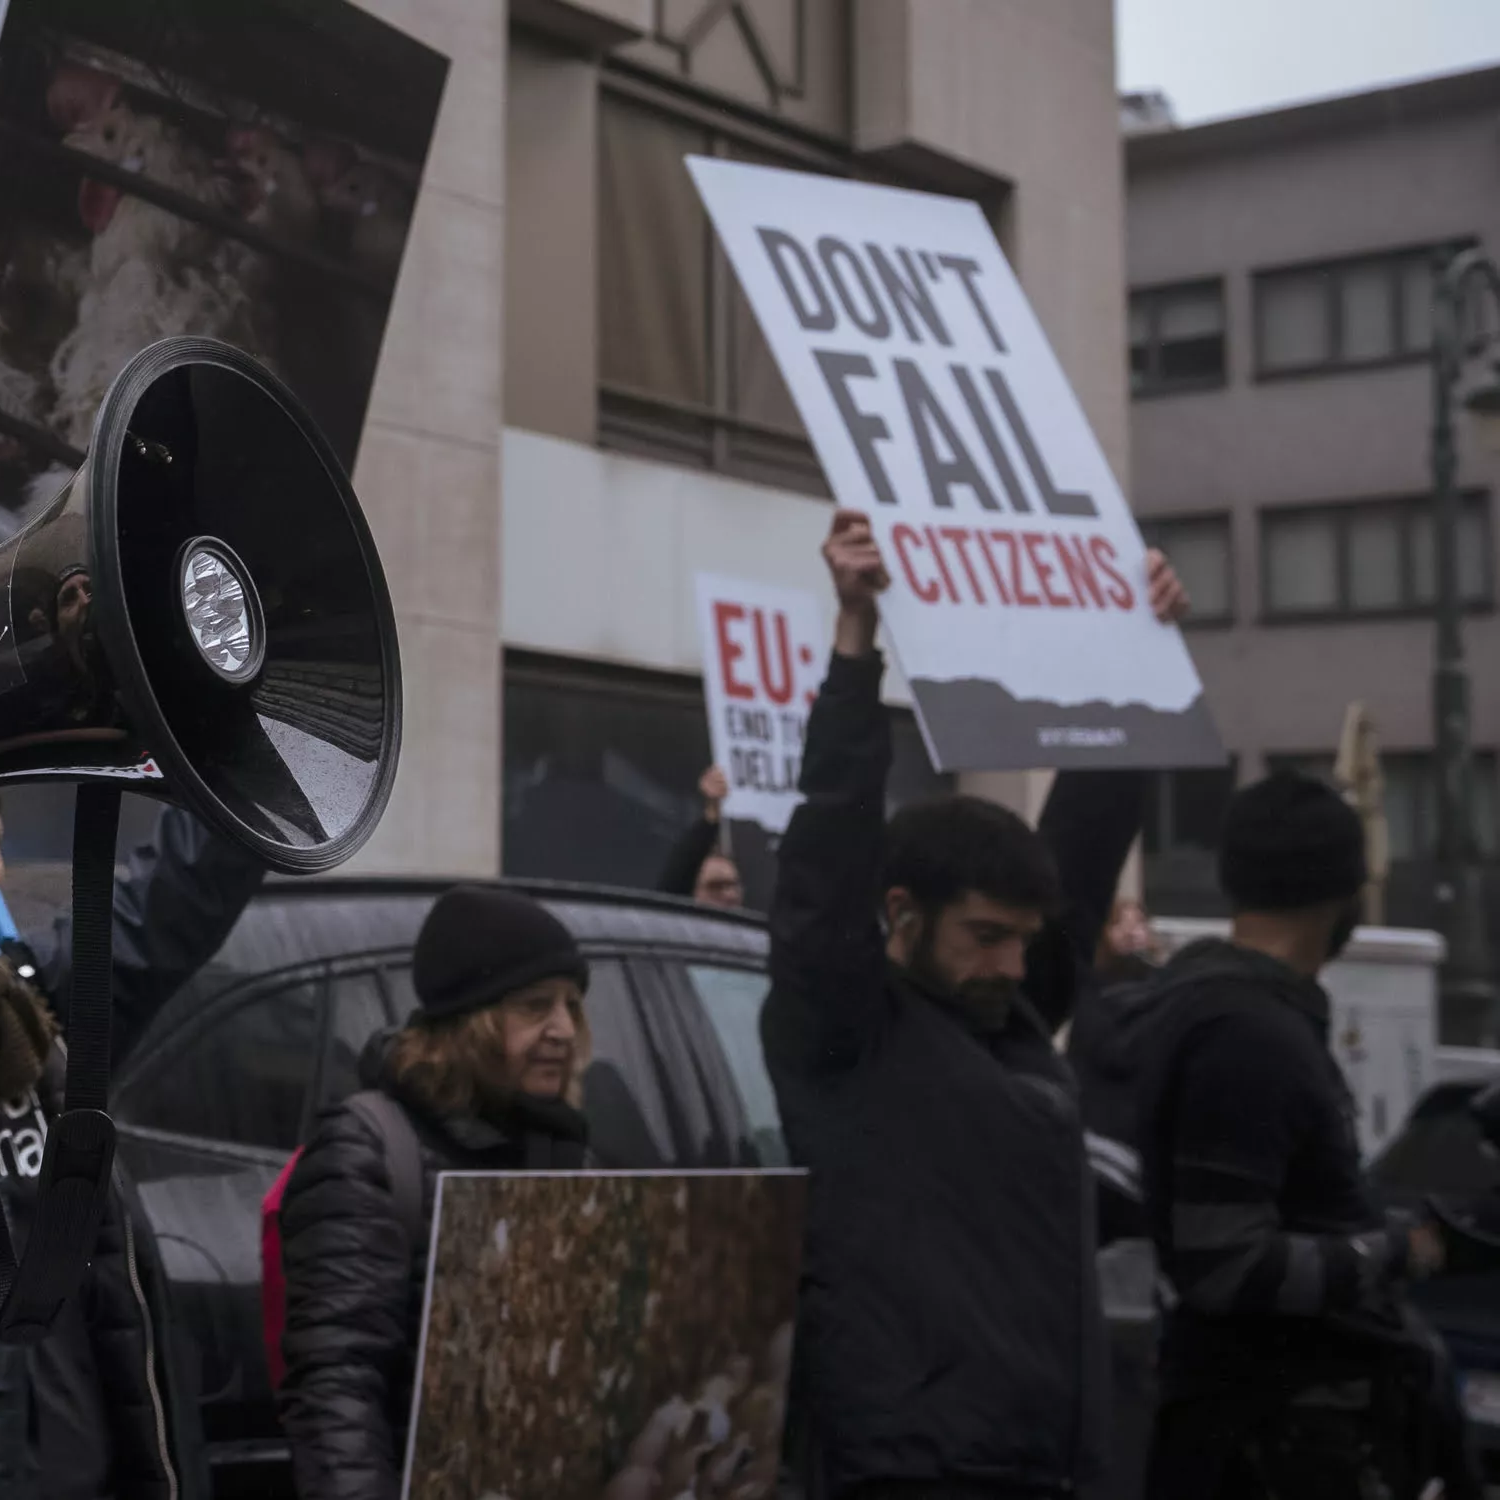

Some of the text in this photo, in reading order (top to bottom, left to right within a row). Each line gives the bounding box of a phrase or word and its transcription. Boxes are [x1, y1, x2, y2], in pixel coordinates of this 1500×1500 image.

[754, 225, 1010, 355] DON'T
[811, 348, 1100, 518] FAIL
[891, 521, 1138, 612] CITIZENS
[725, 704, 773, 743] END
